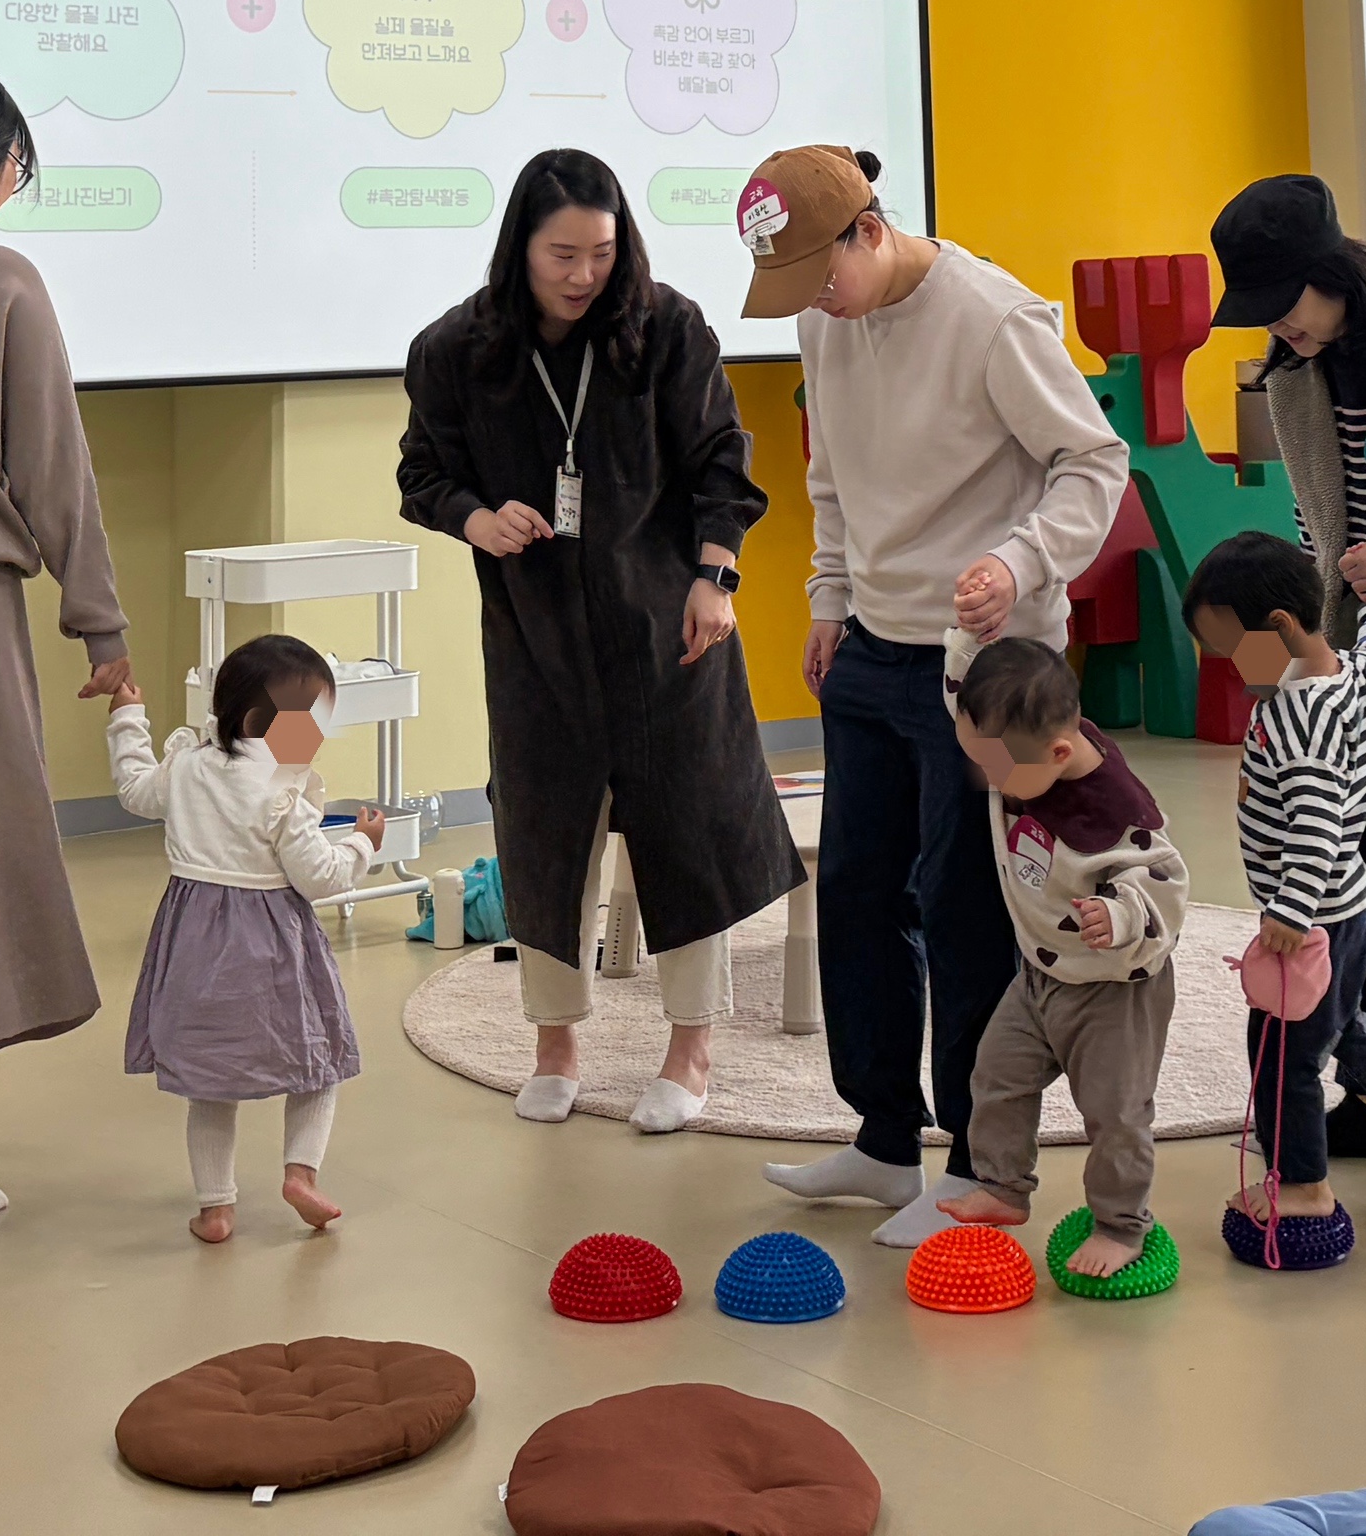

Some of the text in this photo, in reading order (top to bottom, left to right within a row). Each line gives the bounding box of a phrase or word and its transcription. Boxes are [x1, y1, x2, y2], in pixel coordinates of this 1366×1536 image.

[5, 2, 139, 26] 다양한 물질 사진
[375, 16, 454, 37] 실제 물질을
[653, 24, 755, 45] 촉감 언어 부르기
[37, 32, 108, 53] 관찰해요
[362, 43, 471, 63] 만져보고 느껴요
[653, 50, 756, 70] 비슷한 촉감 찾아
[678, 76, 734, 94] 배달놀이
[366, 188, 470, 207] #촉감탐색활동
